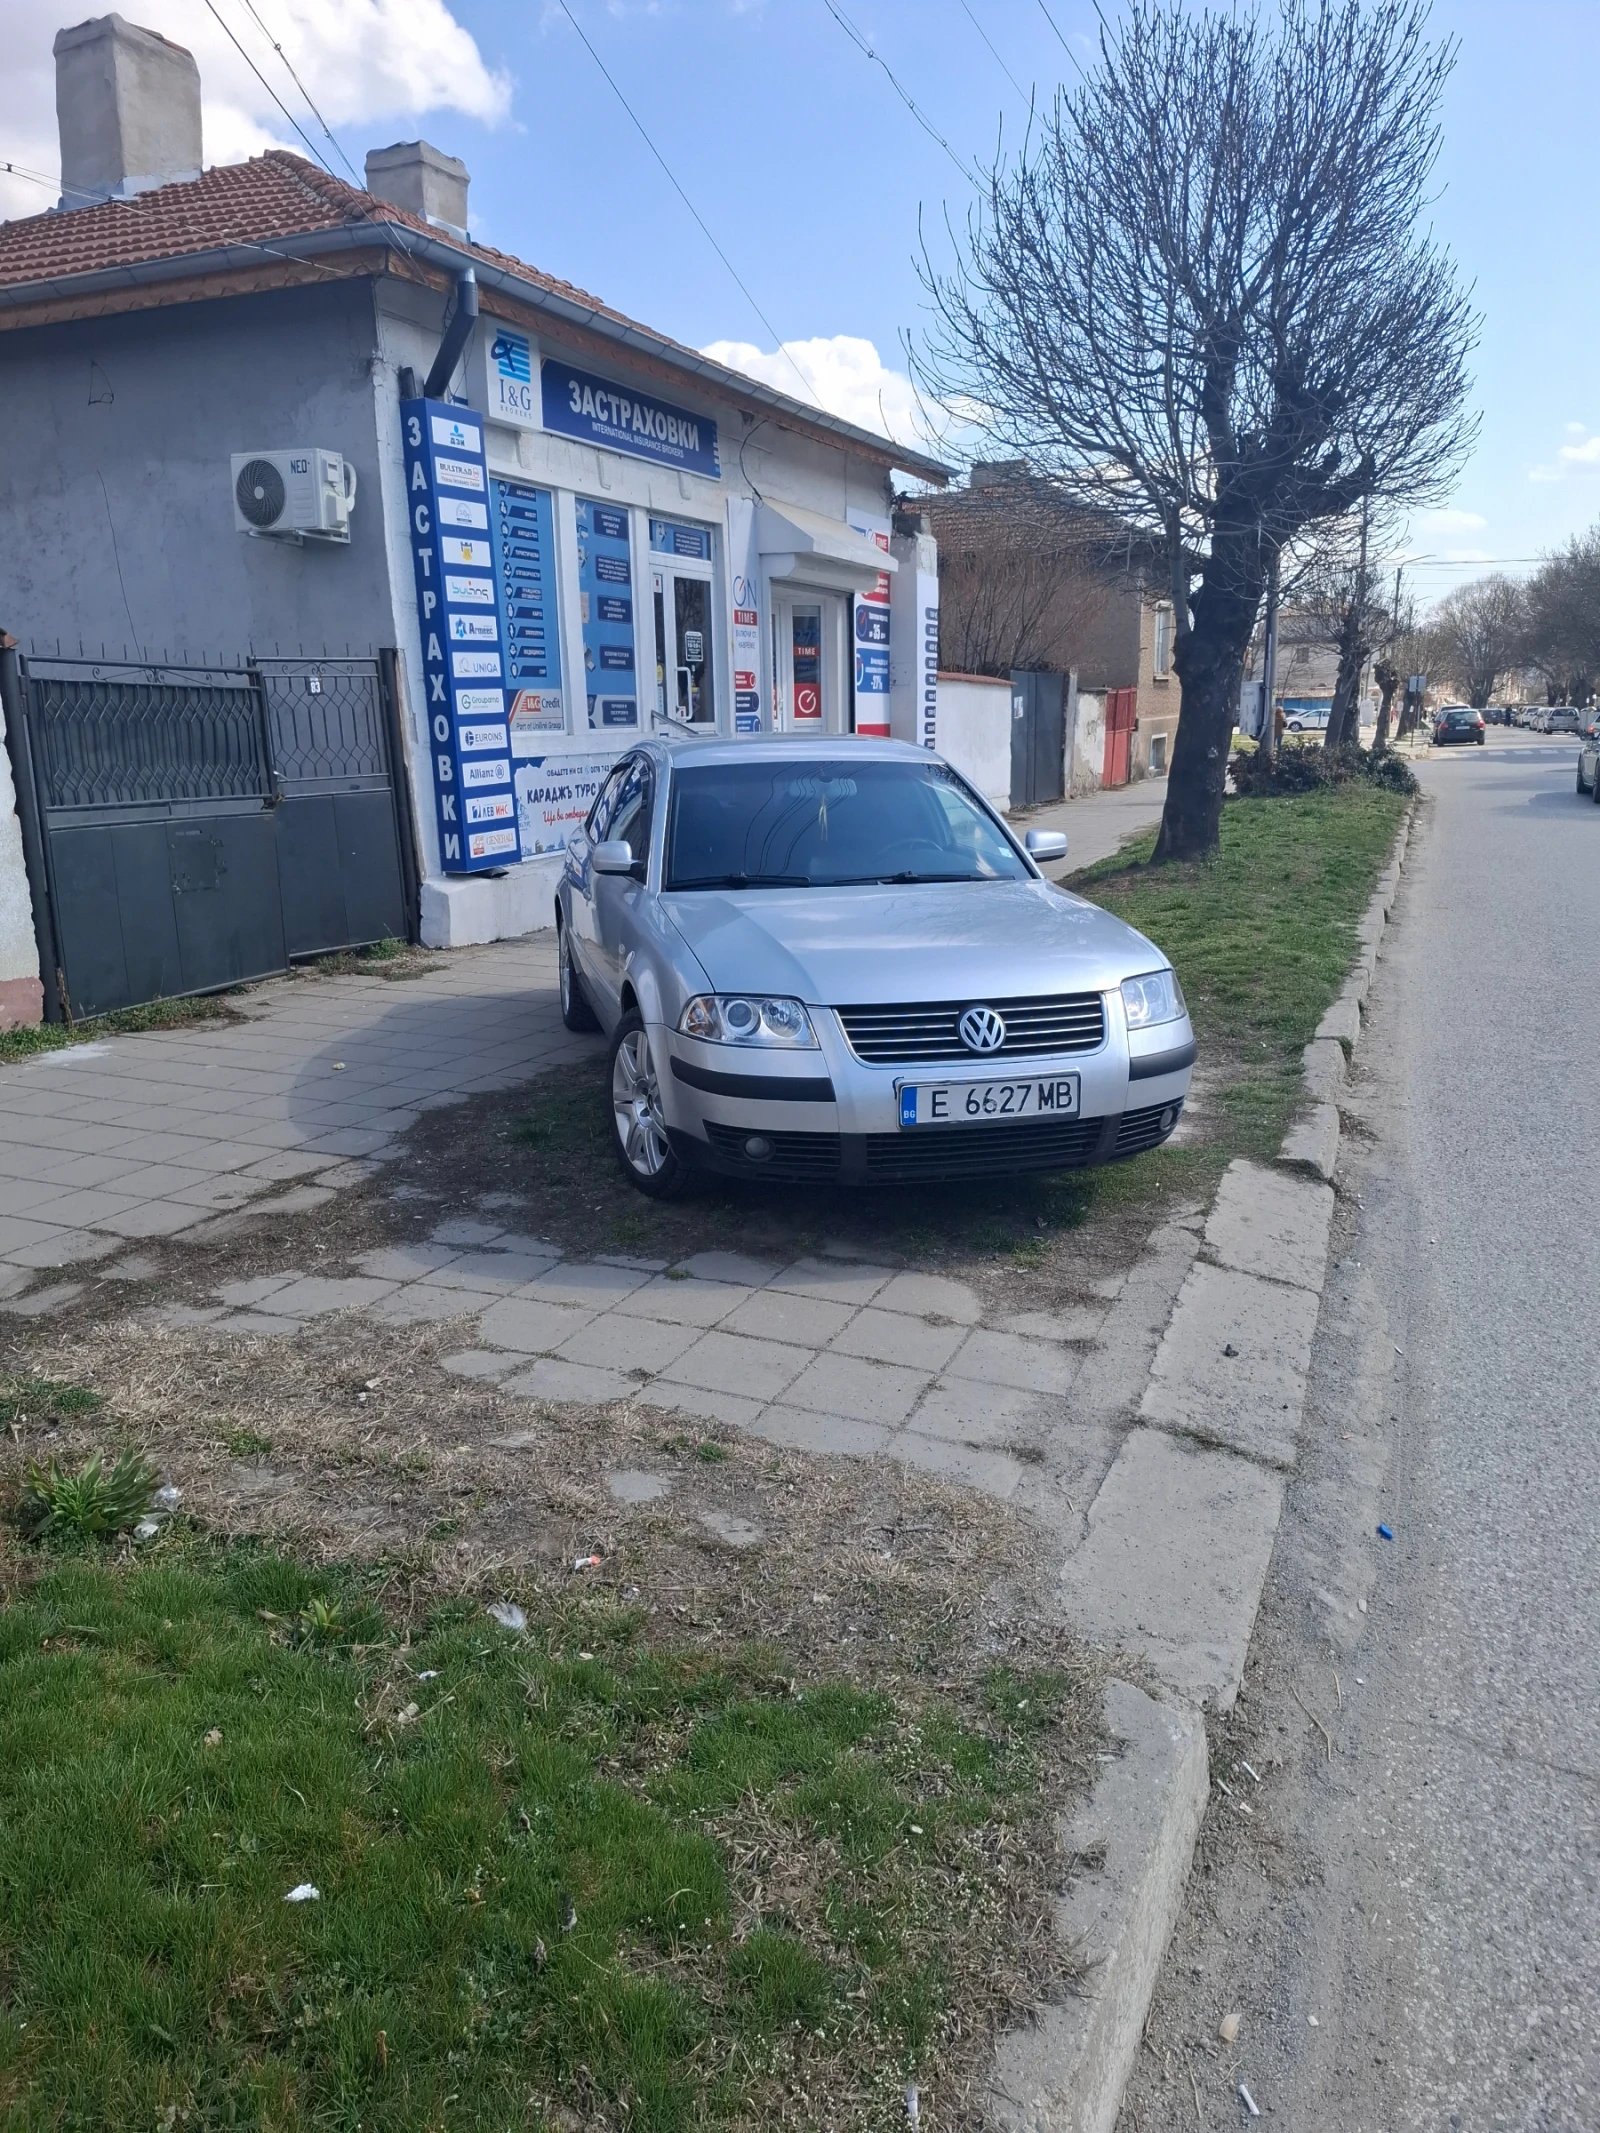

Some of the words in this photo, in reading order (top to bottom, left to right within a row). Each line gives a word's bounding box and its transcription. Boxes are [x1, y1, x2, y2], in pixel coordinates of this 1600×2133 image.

[499, 378, 532, 411] I&G
[500, 404, 532, 420] BROKERS
[568, 380, 700, 452] ЗАСТРАХОВКИ
[450, 437, 465, 447] ДЗИ
[591, 421, 634, 443] INTERNATIONAL
[633, 434, 662, 452] INSURANCE
[661, 443, 685, 459] BROKERS
[290, 459, 308, 474] NEO
[440, 462, 473, 476] BULSTRAD
[737, 611, 754, 624] TIME
[469, 622, 494, 635] Armeec
[407, 416, 461, 860] ЗАСТРАХОВКИ
[797, 647, 816, 656] TIME
[473, 662, 498, 673] UNIQA
[526, 697, 541, 709] I&G
[541, 697, 561, 709] Credit
[474, 732, 503, 743] EUROINS
[469, 768, 495, 780] Allianz
[546, 768, 569, 777] ОБАДЕТЕ
[526, 784, 573, 805] КАРАДЖЪ
[574, 782, 597, 799] ТУРС
[482, 806, 495, 818] ЛЕВ
[495, 804, 508, 816] ИНС
[486, 832, 514, 845] GENERALI
[931, 1089, 949, 1118] E
[965, 1084, 1032, 1115] 6627
[1037, 1081, 1073, 1111] MB
[903, 1110, 916, 1119] BG
